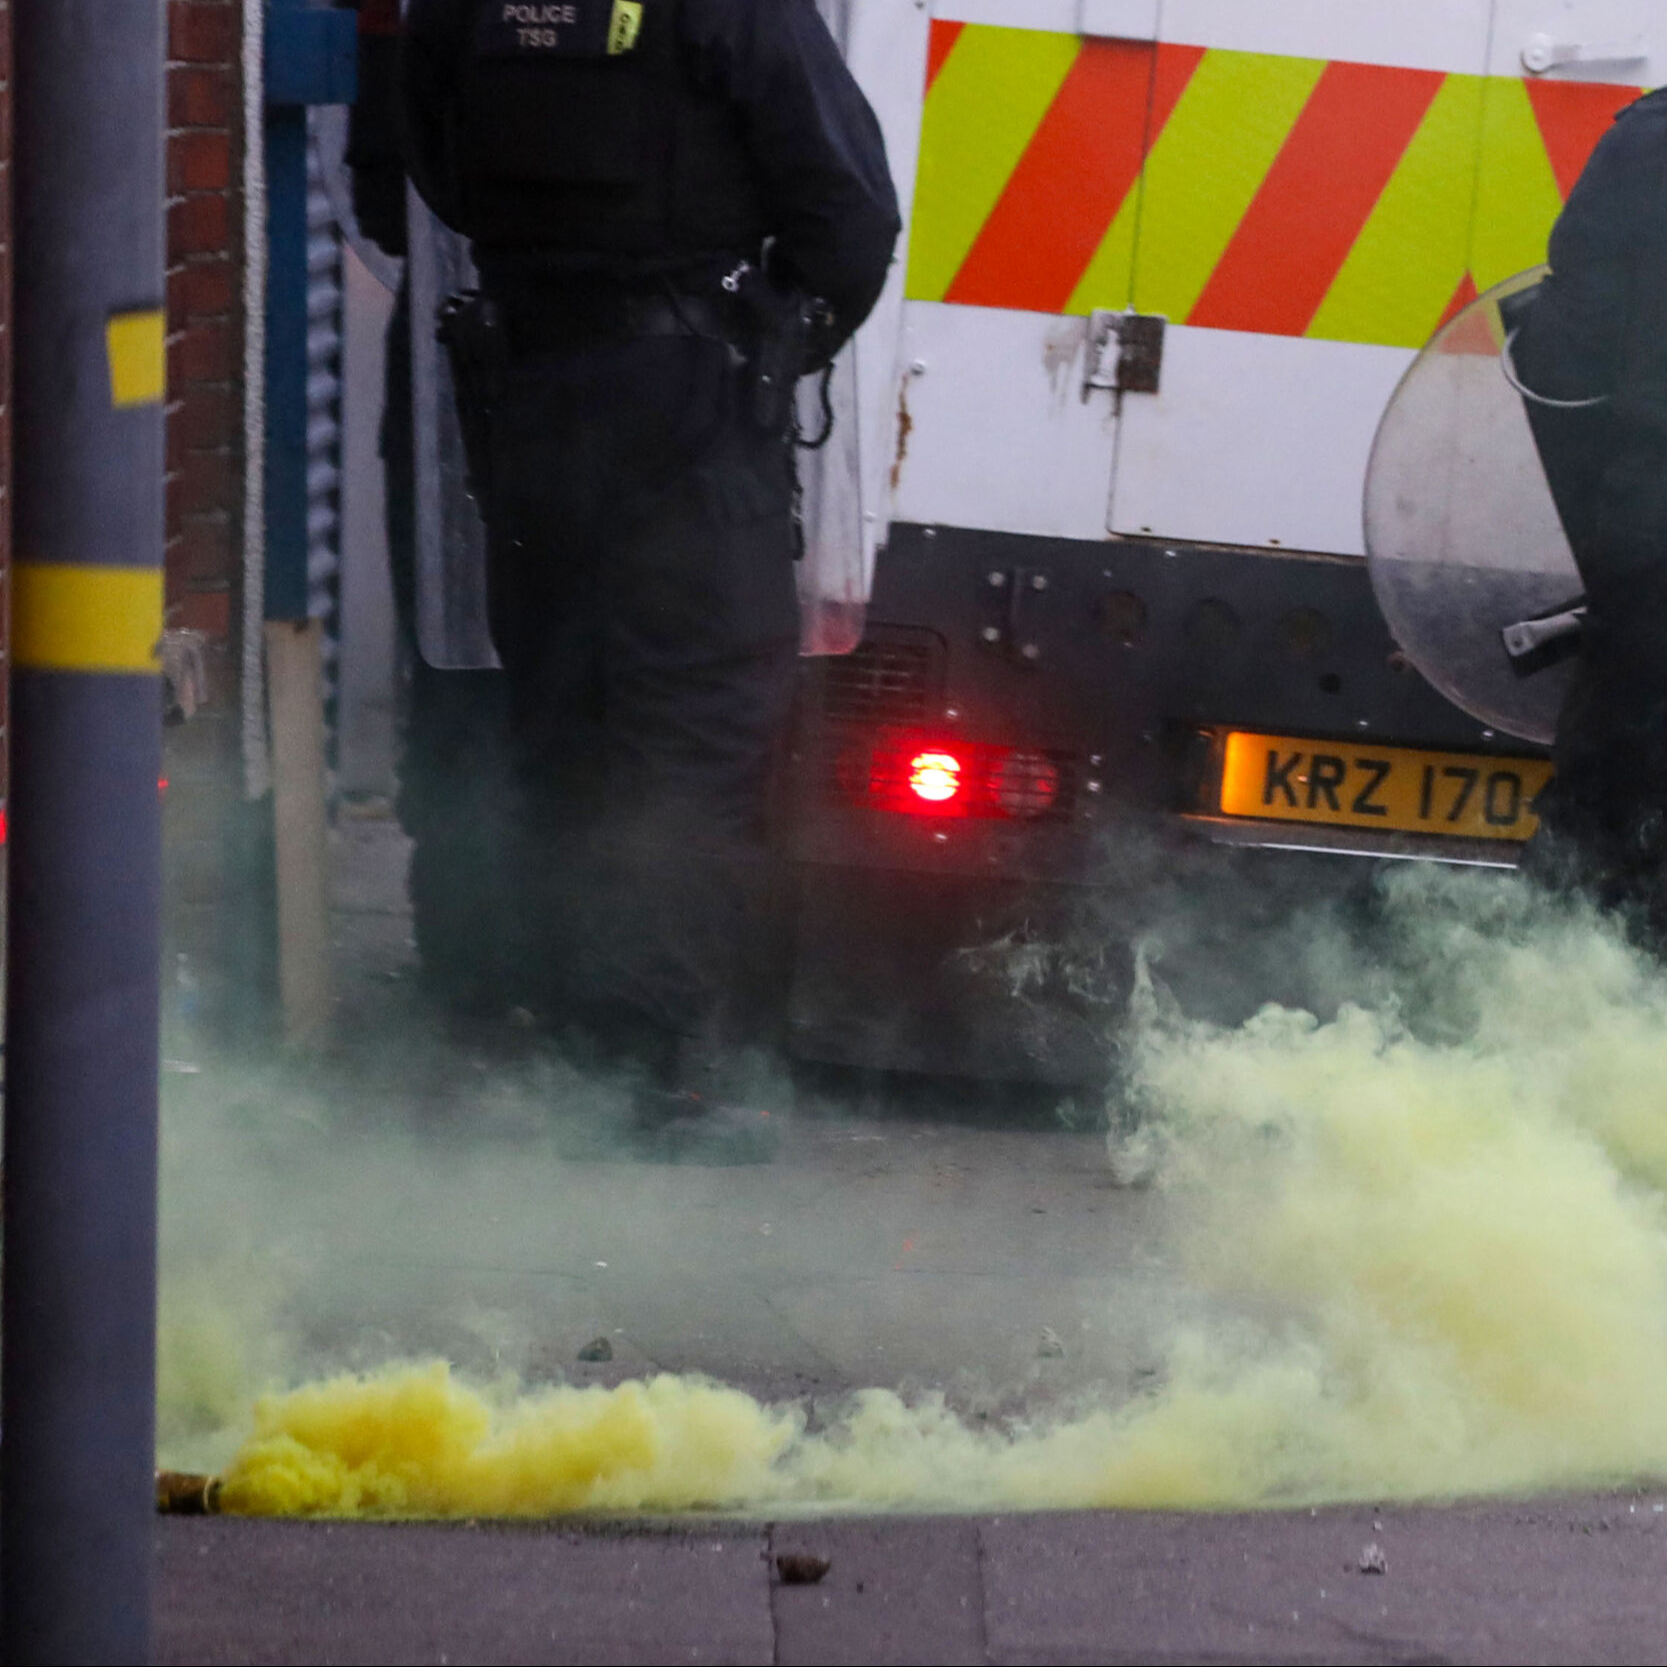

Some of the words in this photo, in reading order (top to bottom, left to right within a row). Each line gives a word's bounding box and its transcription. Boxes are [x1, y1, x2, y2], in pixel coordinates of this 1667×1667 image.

[503, 3, 577, 25] POLICE
[516, 28, 558, 48] TSG
[1262, 749, 1393, 818] KRZ
